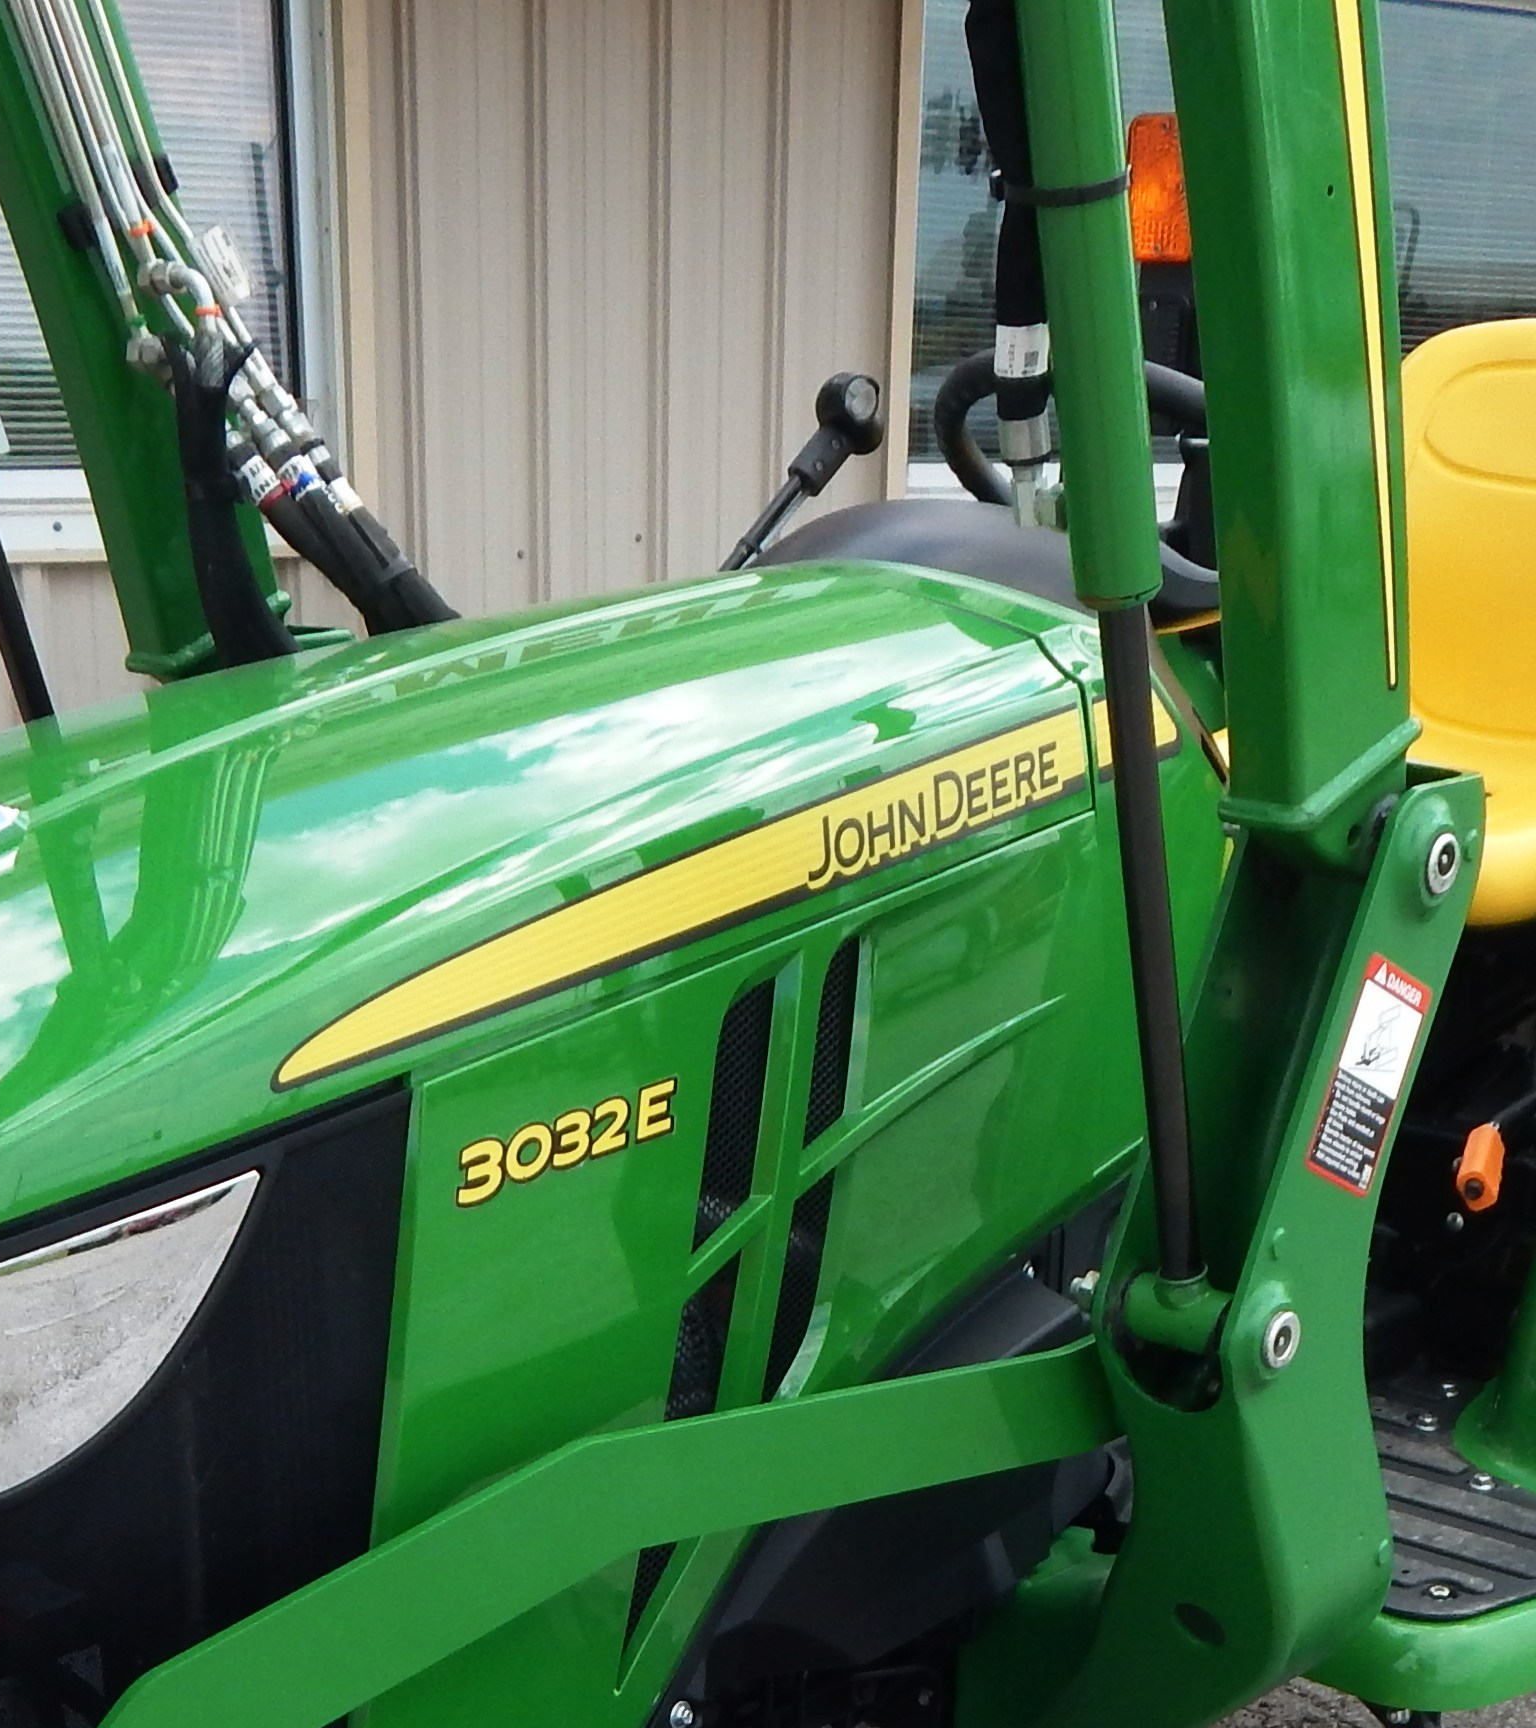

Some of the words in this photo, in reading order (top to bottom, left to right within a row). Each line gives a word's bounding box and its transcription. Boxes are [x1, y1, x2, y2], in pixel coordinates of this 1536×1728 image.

[808, 792, 926, 882] JOHN
[933, 741, 1059, 832] DEERE
[1386, 972, 1422, 1007] DANGER
[456, 1077, 677, 1207] 3032E
